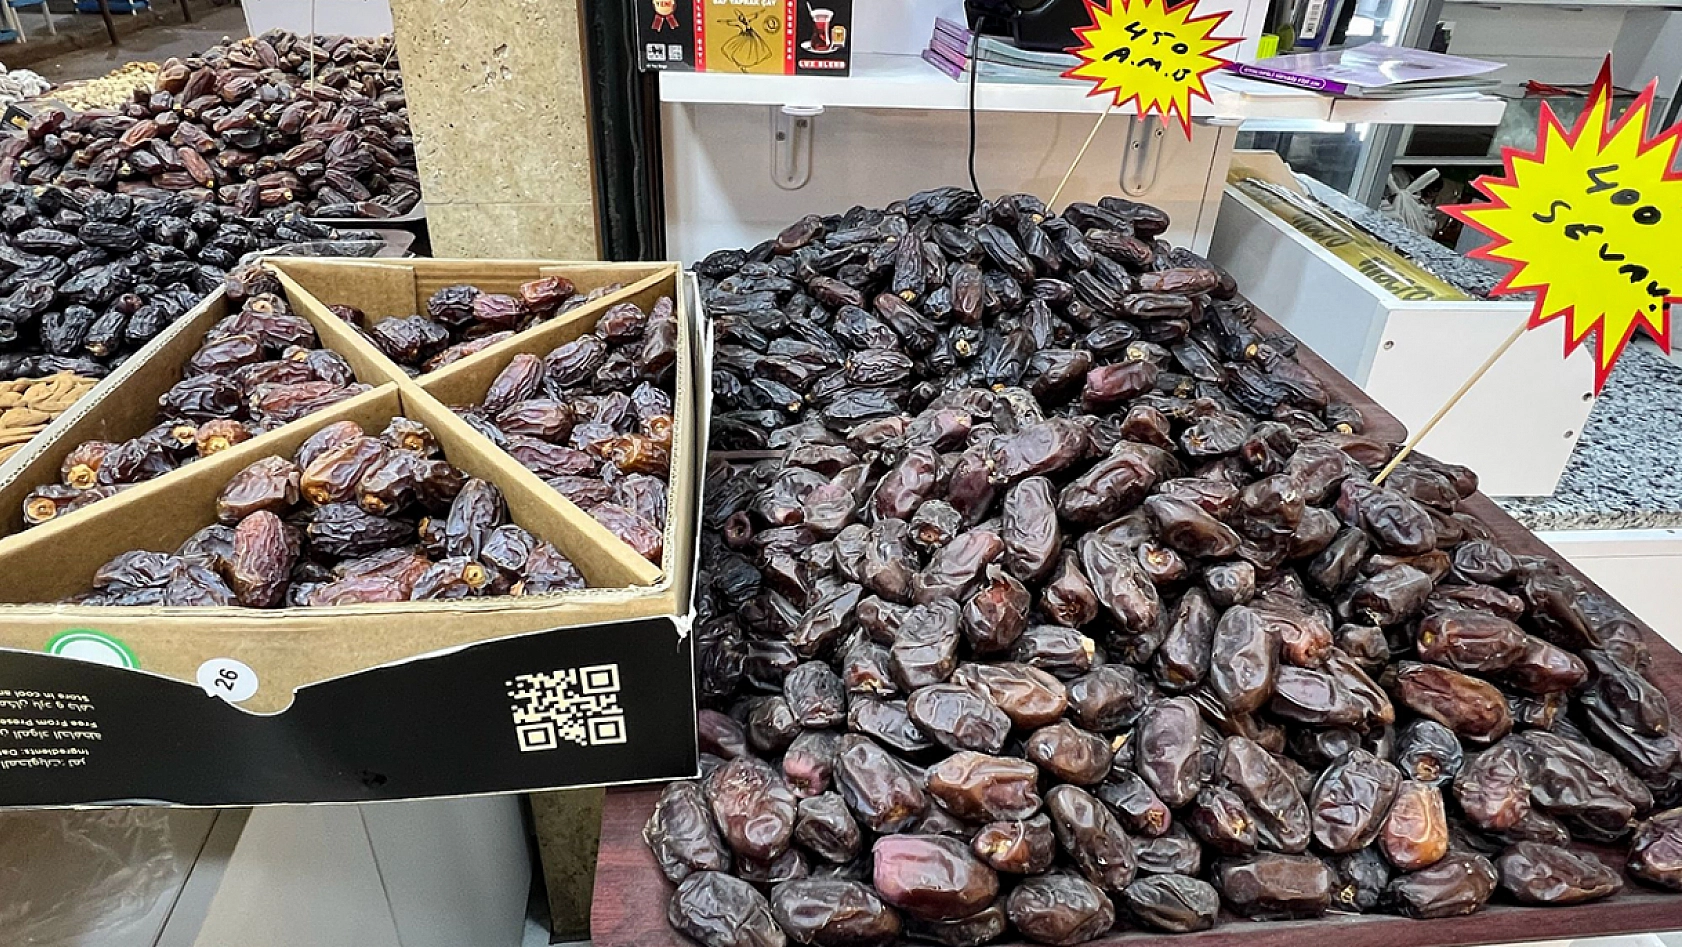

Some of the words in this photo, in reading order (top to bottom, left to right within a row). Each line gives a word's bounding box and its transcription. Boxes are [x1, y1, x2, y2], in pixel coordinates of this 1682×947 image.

[1124, 21, 1189, 55] 450
[1586, 164, 1665, 226] 400
[214, 668, 239, 691] 26
[14, 690, 40, 698] cool
[36, 719, 68, 727] From
[70, 720, 98, 728] Free
